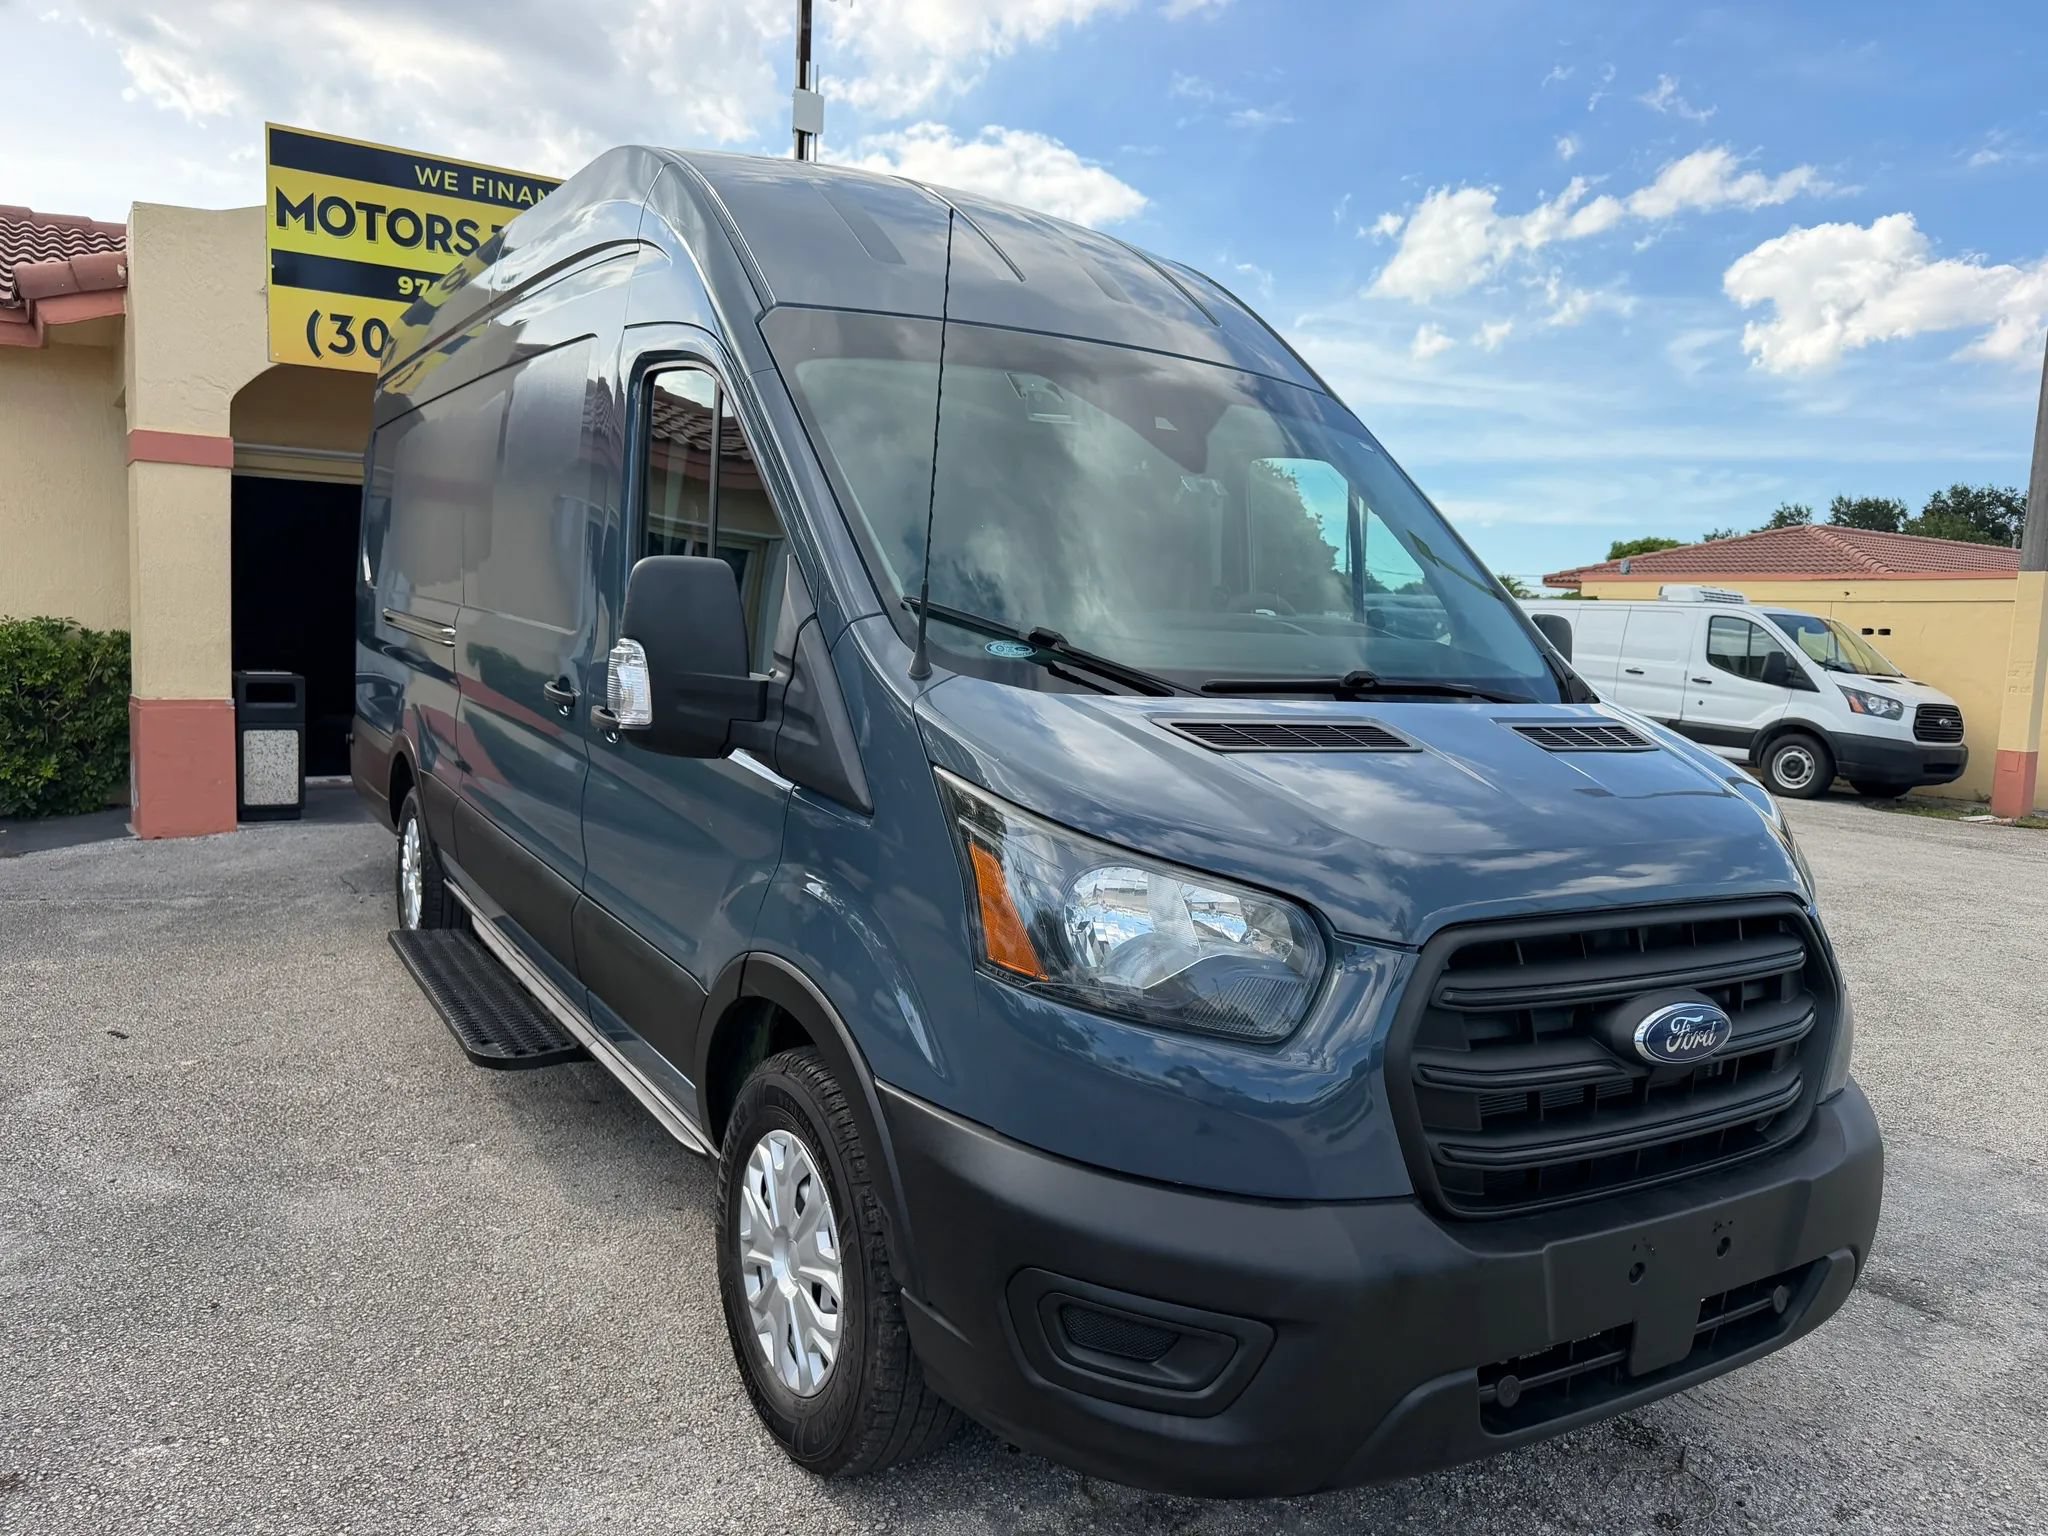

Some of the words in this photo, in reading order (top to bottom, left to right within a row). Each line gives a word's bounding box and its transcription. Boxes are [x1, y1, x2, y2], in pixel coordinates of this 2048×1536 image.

[415, 165, 459, 191] WE
[275, 185, 481, 258] MOTORS
[1666, 1015, 1717, 1053] Ford
